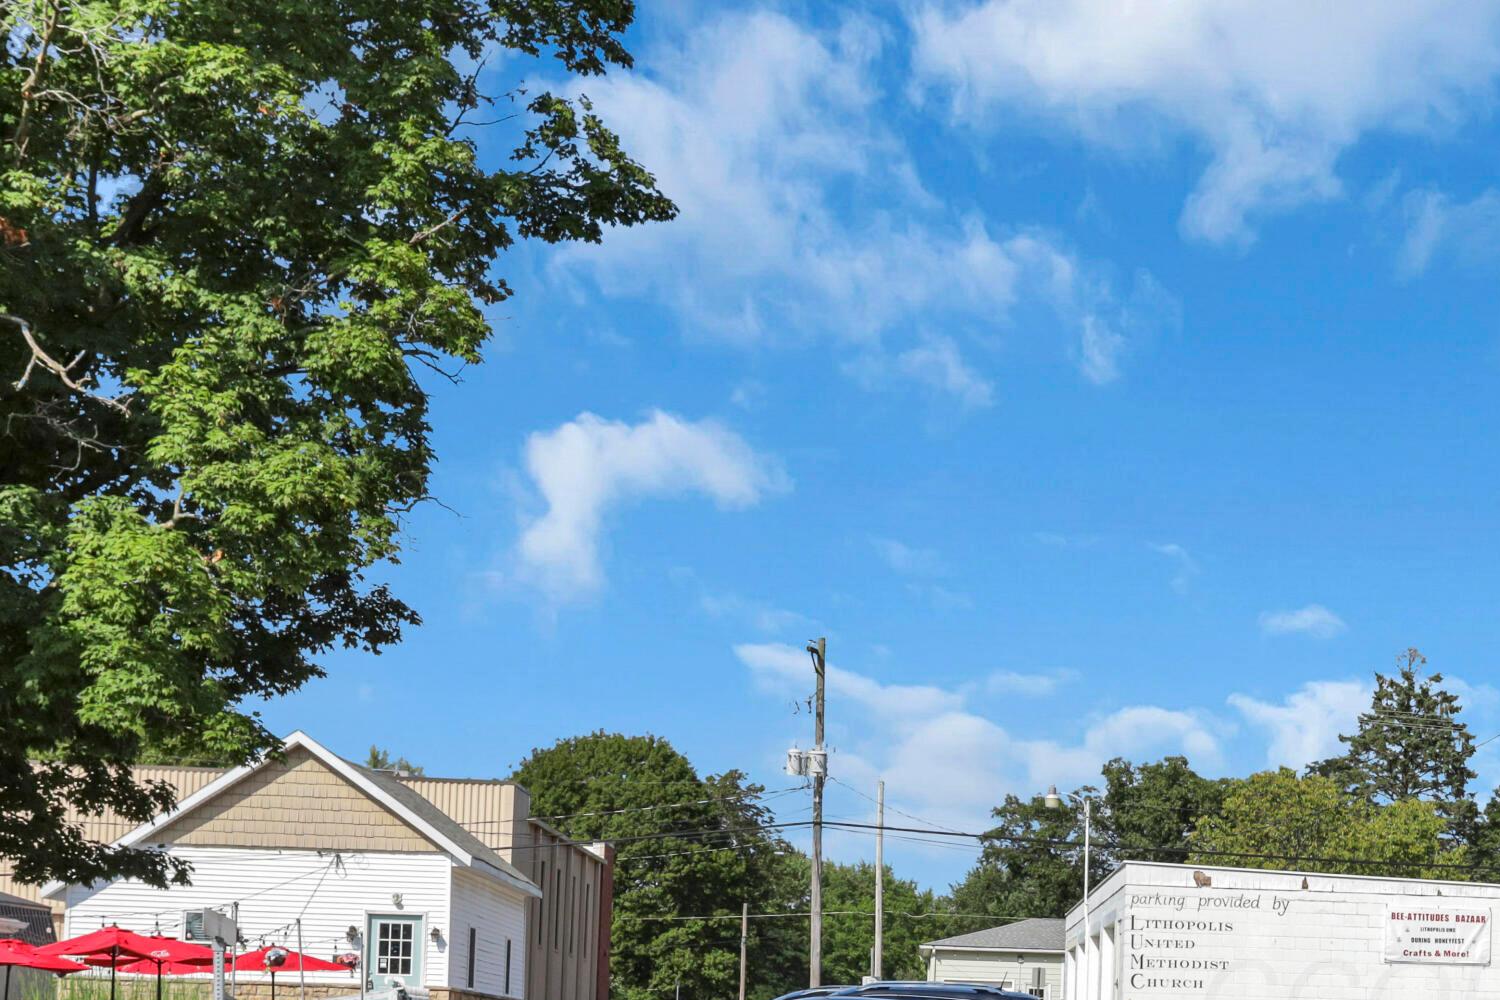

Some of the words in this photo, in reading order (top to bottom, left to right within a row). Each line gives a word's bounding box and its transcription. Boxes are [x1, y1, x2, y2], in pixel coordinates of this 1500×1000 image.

[1130, 892, 1186, 911] parking
[1197, 893, 1262, 912] provided
[1272, 895, 1291, 917] by
[1391, 911, 1450, 922] BEE-ATTITUDES
[1455, 914, 1486, 924] BAZAAR
[1403, 949, 1432, 957] Crafts
[1443, 950, 1469, 958] More!
